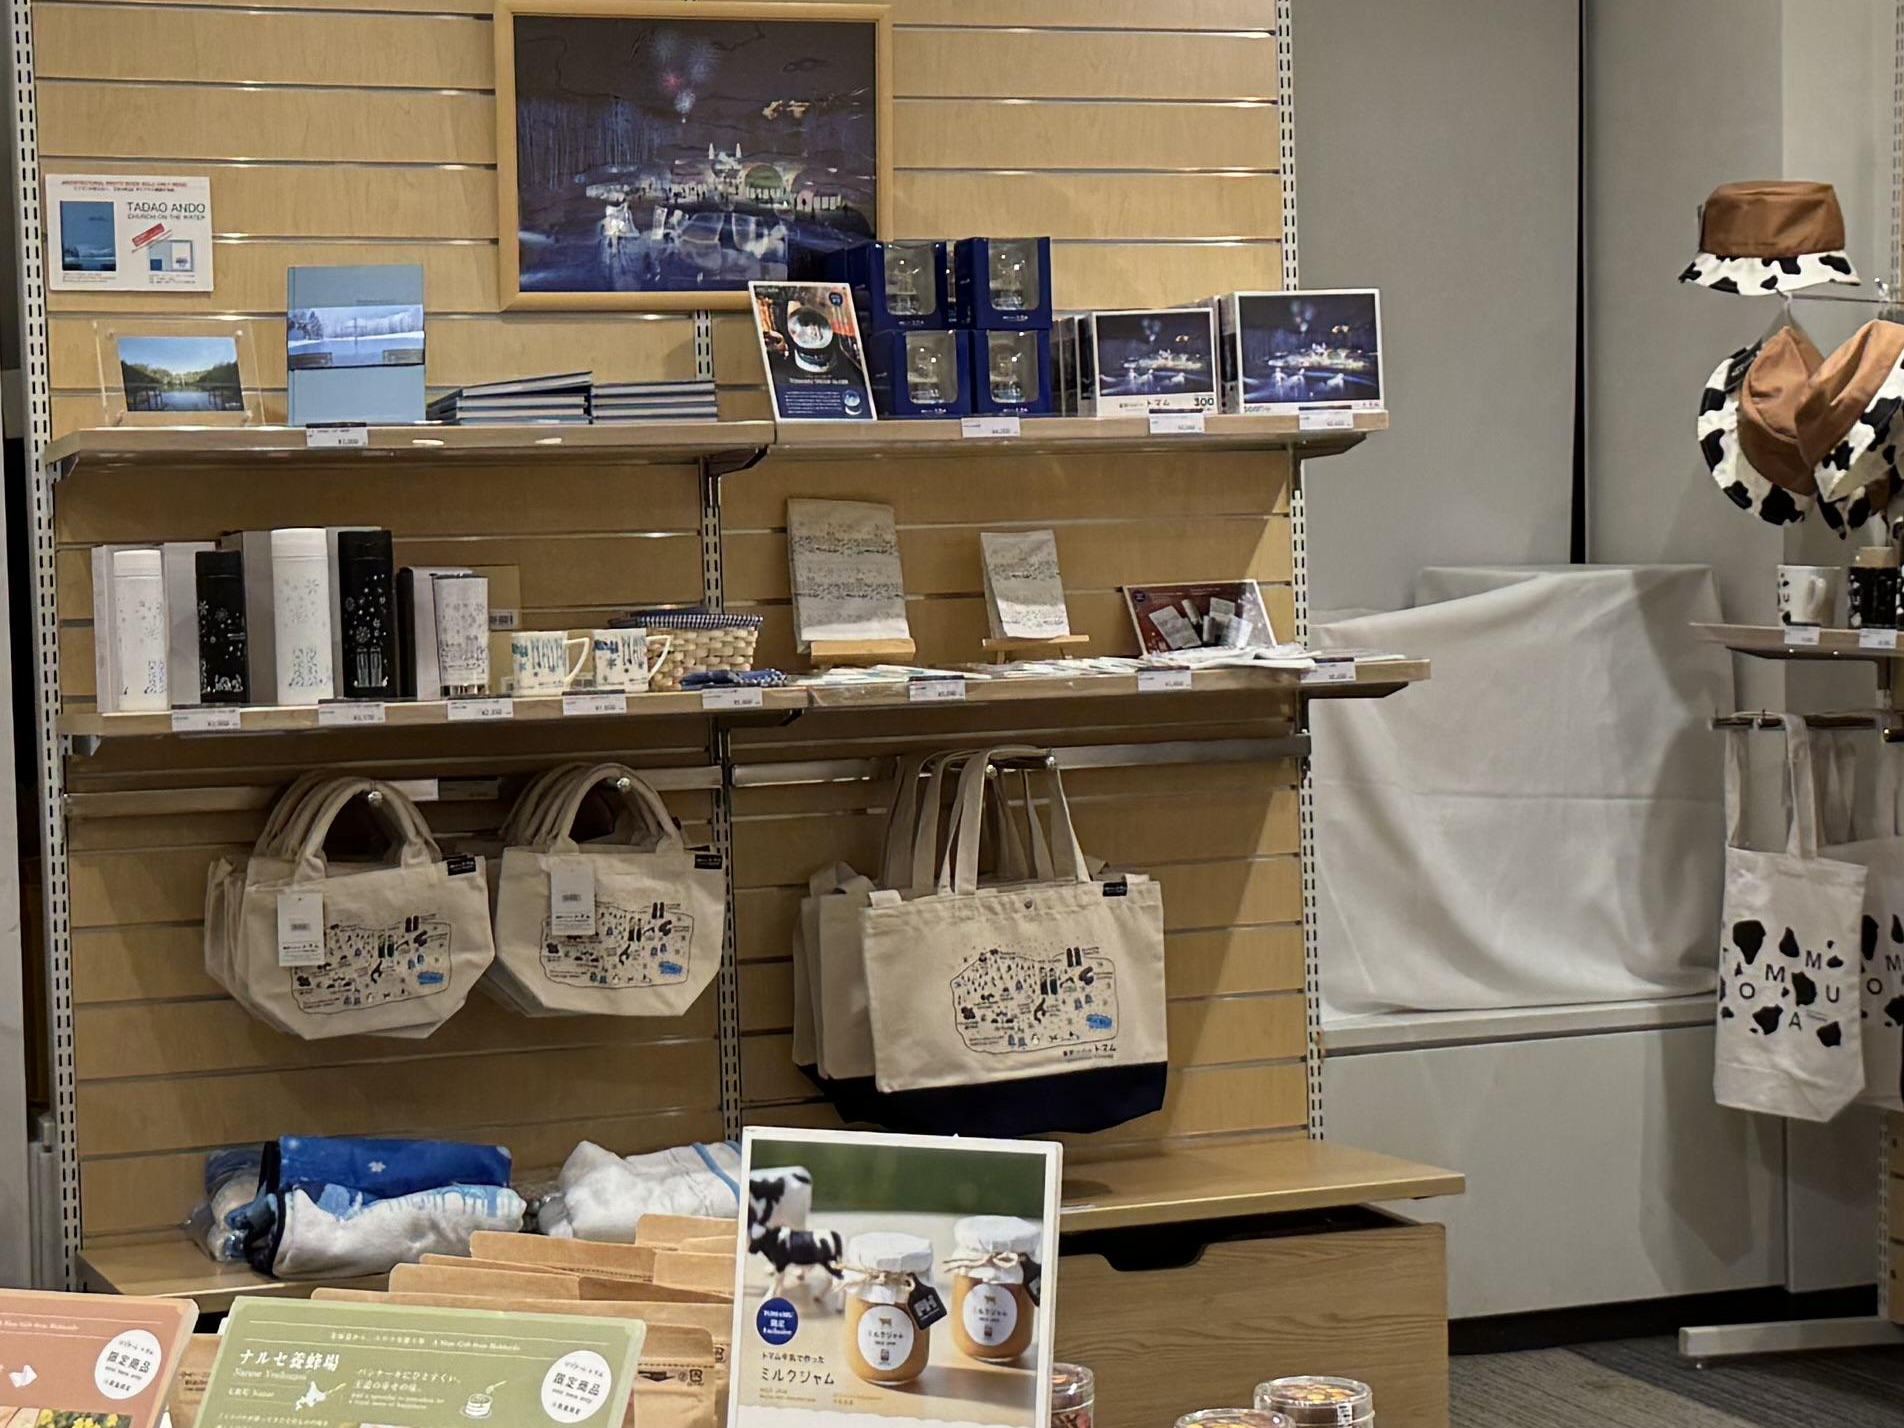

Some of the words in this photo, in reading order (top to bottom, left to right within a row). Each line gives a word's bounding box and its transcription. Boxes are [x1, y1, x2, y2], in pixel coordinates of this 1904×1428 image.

[127, 202, 167, 213] TADAO
[172, 203, 206, 214] ANDO
[106, 1351, 151, 1373] 限定商品
[239, 1349, 341, 1371] ナルセ養蜂場
[762, 1352, 824, 1363] トマム牛乳で作った
[553, 1372, 600, 1396] 限定商品
[761, 1367, 835, 1386] ミルクジャム
